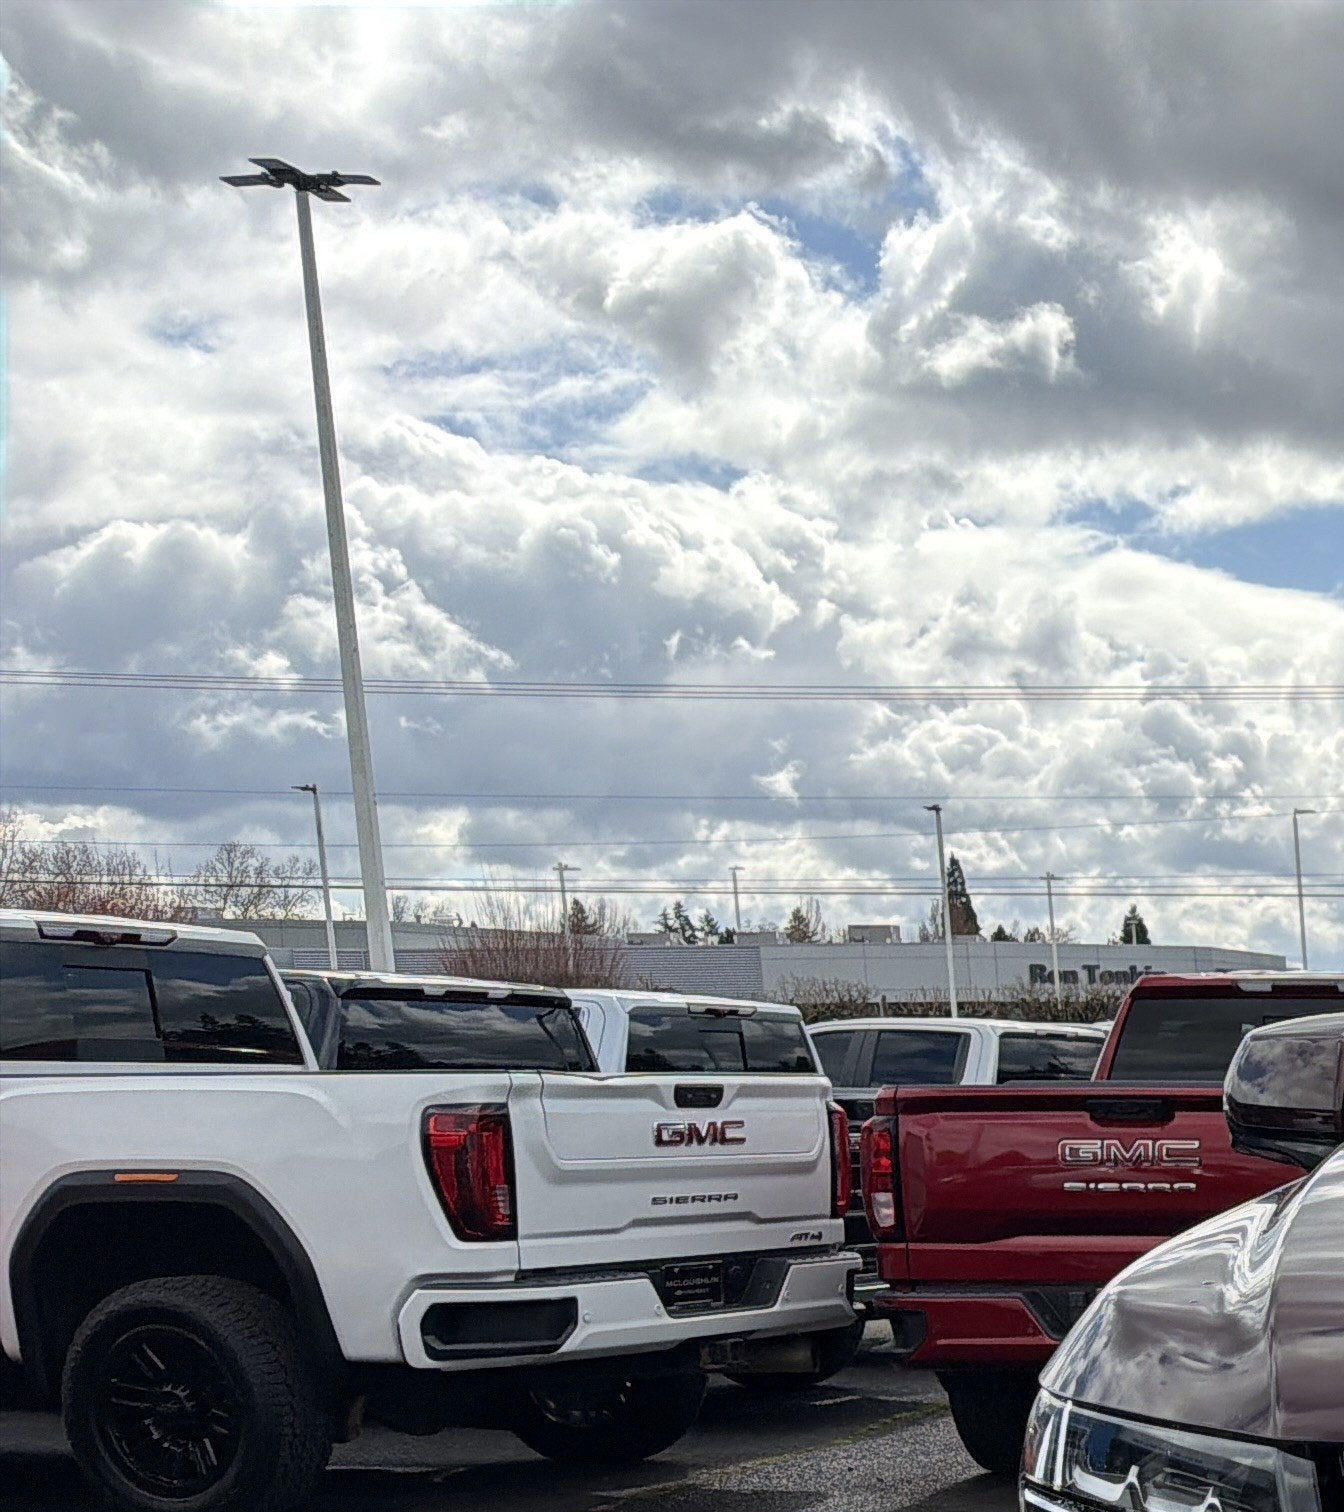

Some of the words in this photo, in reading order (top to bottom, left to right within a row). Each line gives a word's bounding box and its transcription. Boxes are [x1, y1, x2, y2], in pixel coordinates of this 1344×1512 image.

[653, 1120, 747, 1147] GMC
[1058, 1139, 1200, 1168] GMC
[651, 1193, 739, 1206] SIERRA
[790, 1231, 822, 1242] AT4
